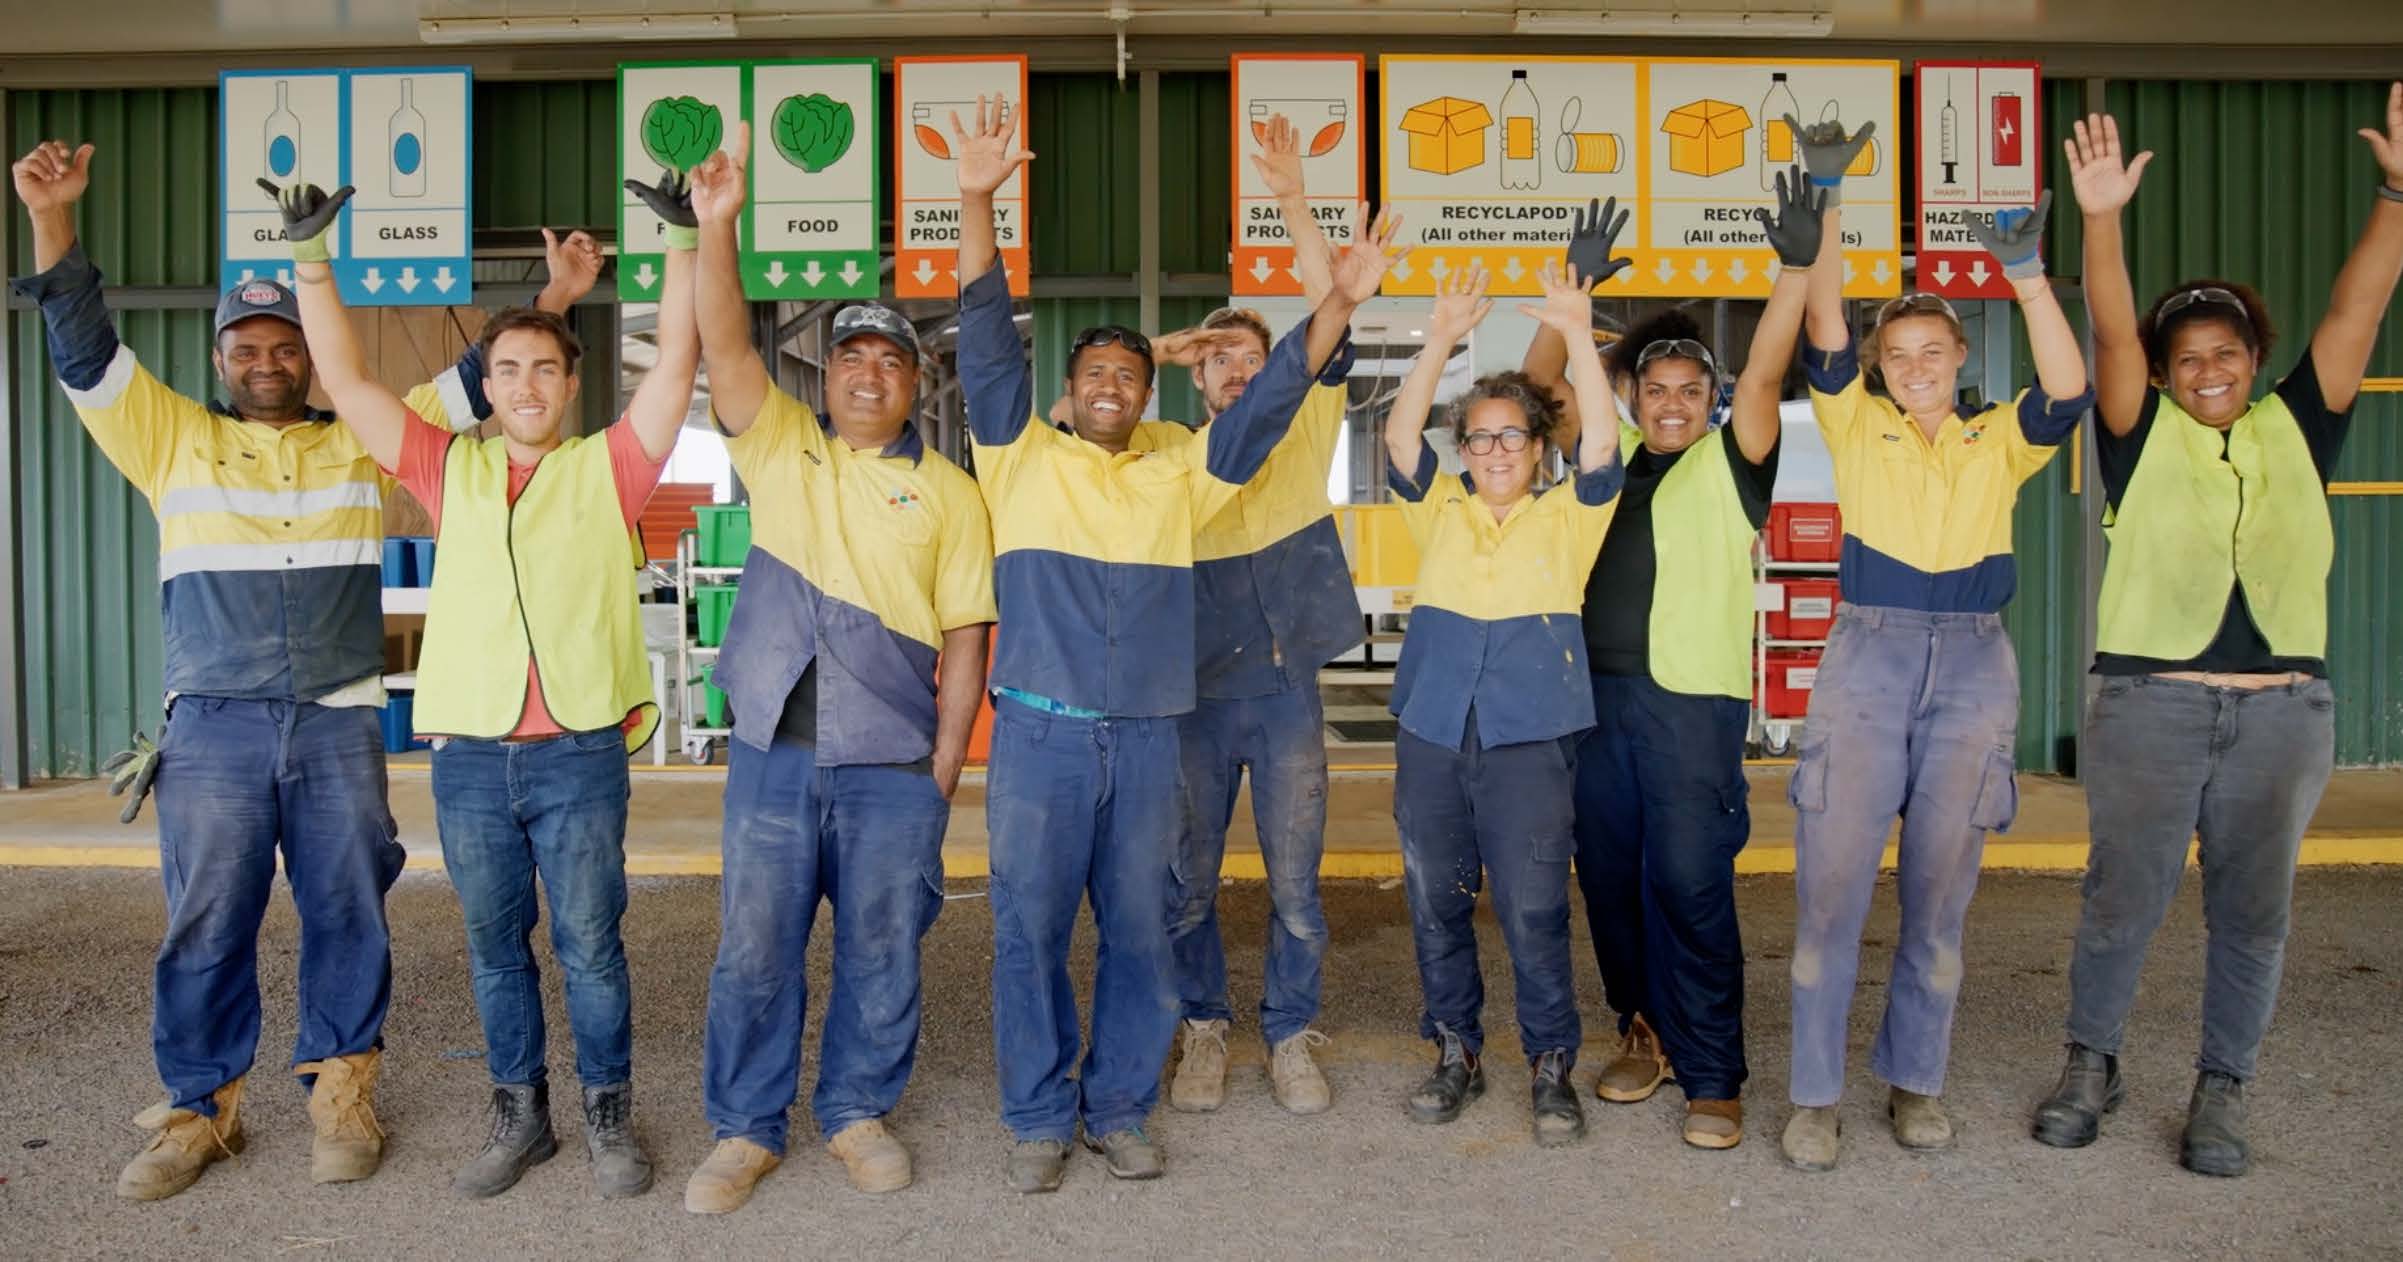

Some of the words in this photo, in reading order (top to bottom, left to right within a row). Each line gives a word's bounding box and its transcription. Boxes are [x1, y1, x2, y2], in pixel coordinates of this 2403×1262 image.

[914, 209, 1008, 222] SANIY
[1250, 207, 1345, 220] SAARY
[788, 219, 839, 233] FOOD
[1247, 225, 1350, 238] PROTS
[254, 229, 289, 241] GLA
[379, 226, 438, 240] GLASS
[1421, 227, 1451, 243] (All
[1457, 228, 1506, 241] other
[1512, 228, 1571, 241] materi
[1684, 229, 1713, 245] (All
[1719, 230, 1767, 243] other
